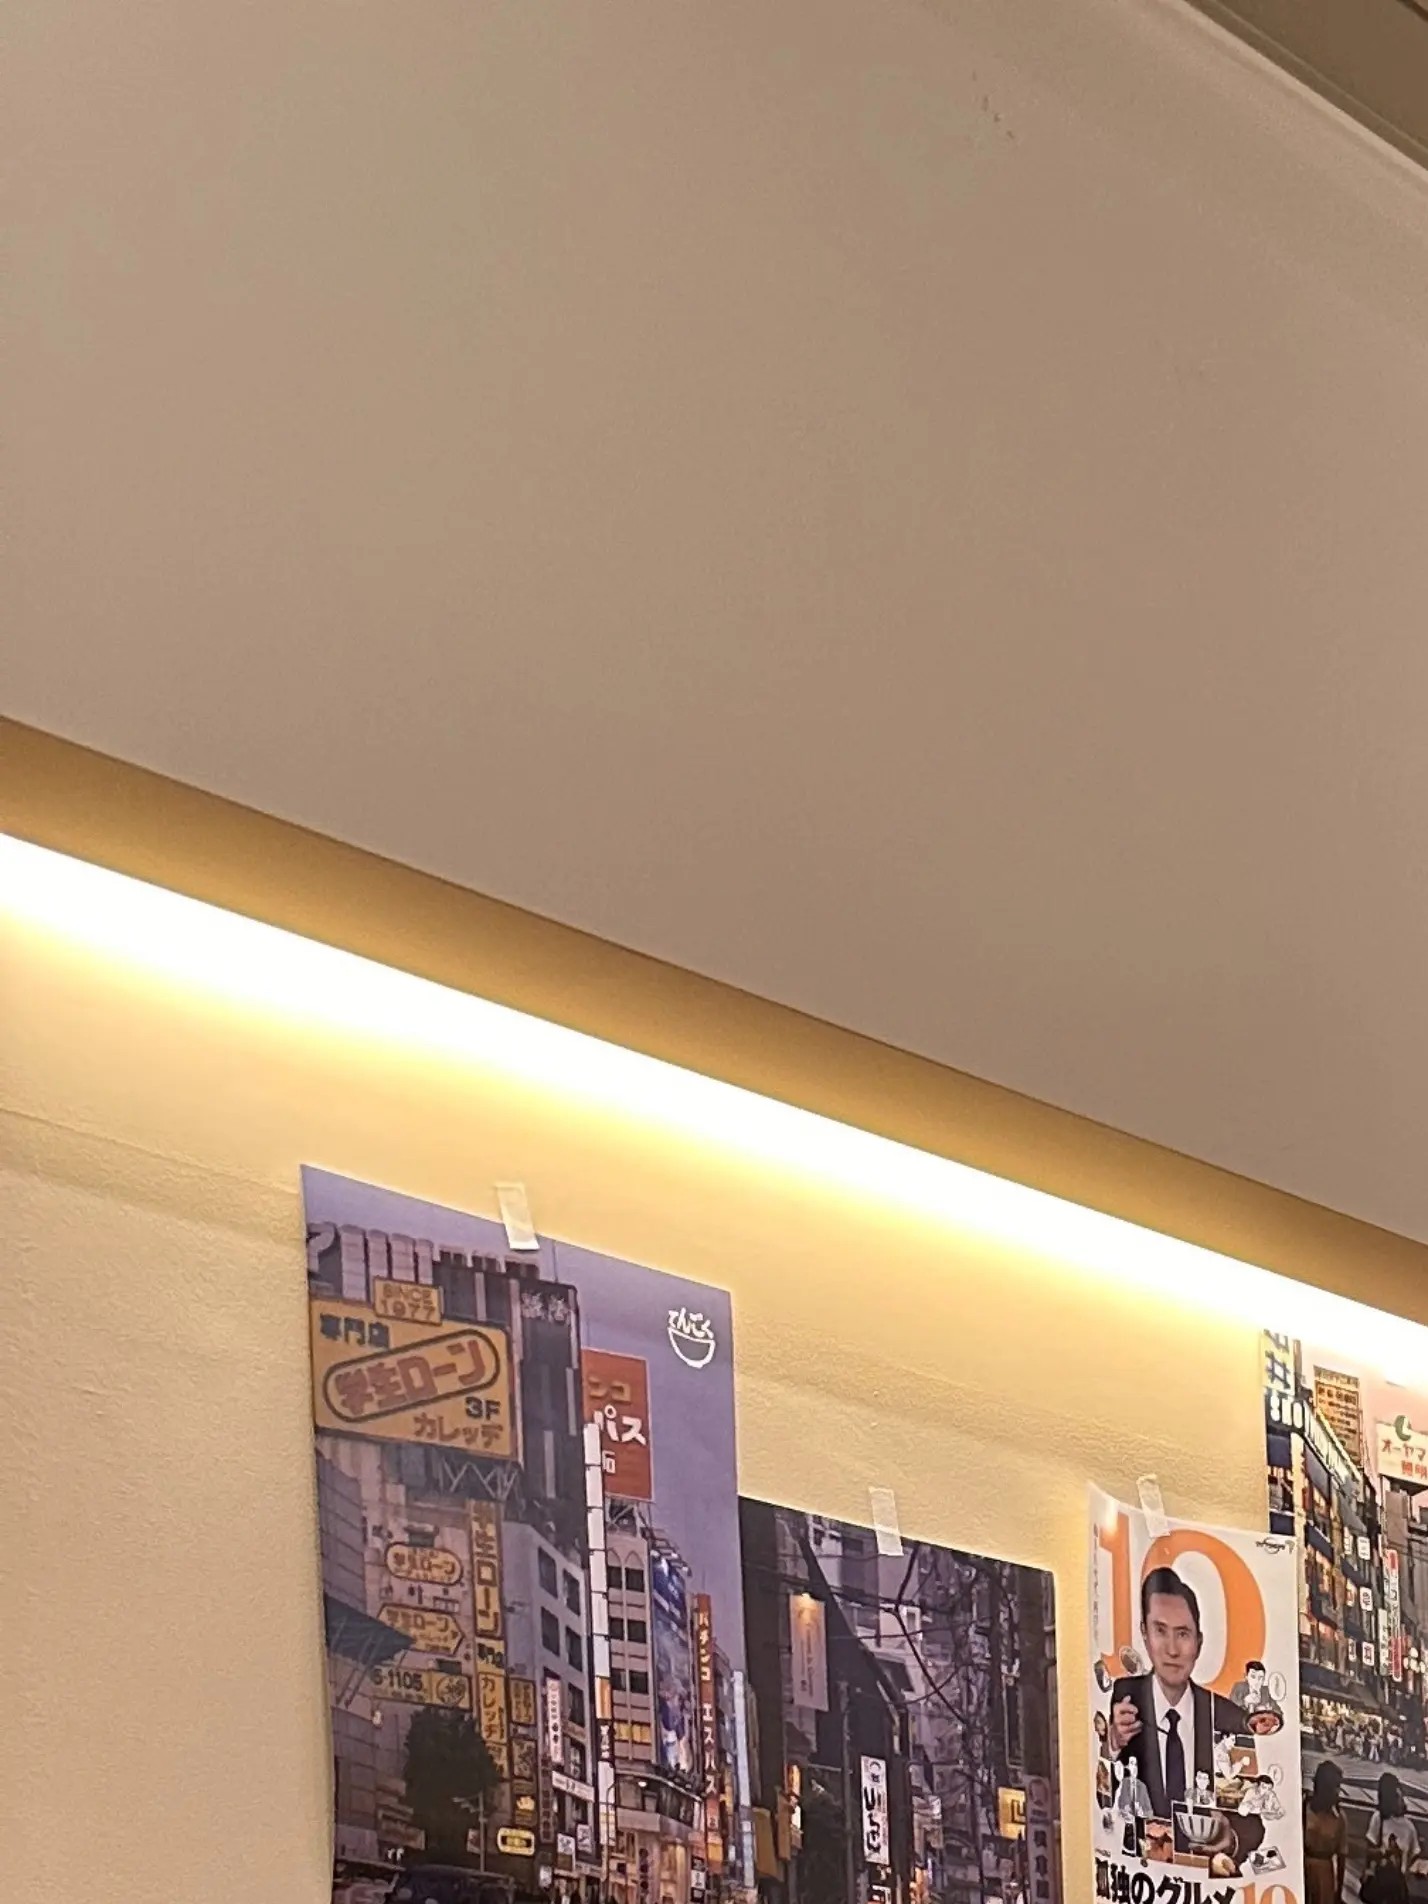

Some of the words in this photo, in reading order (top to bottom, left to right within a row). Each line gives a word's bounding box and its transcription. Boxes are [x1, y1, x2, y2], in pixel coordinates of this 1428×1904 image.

[381, 1300, 435, 1319] 1977
[335, 1338, 486, 1416] 学生ローン
[465, 1396, 501, 1421] 3F
[1380, 1438, 1427, 1462] オーヤマ
